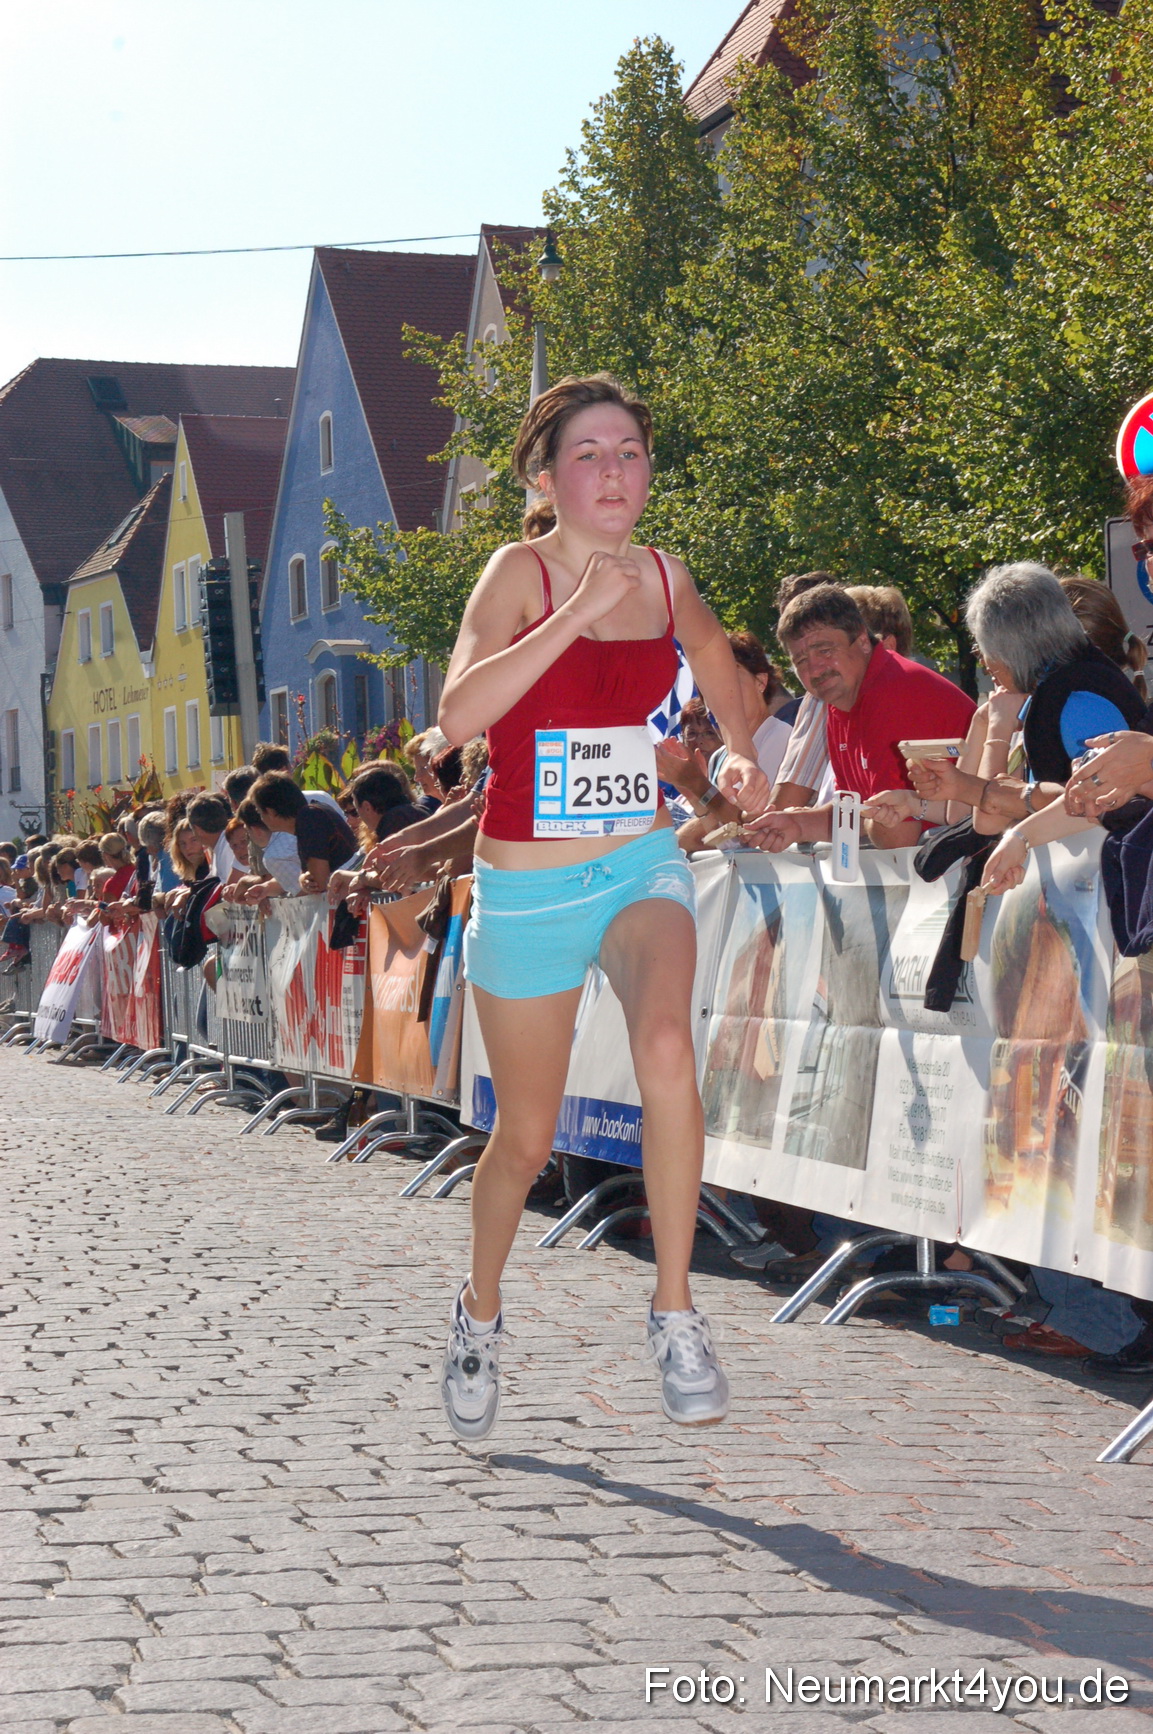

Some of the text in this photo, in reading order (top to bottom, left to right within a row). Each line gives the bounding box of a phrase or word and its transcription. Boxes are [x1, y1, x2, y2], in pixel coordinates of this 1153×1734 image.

[93, 687, 118, 714] HOTEL
[571, 741, 612, 760] Pane
[544, 770, 558, 787] D
[572, 772, 650, 807] 2536
